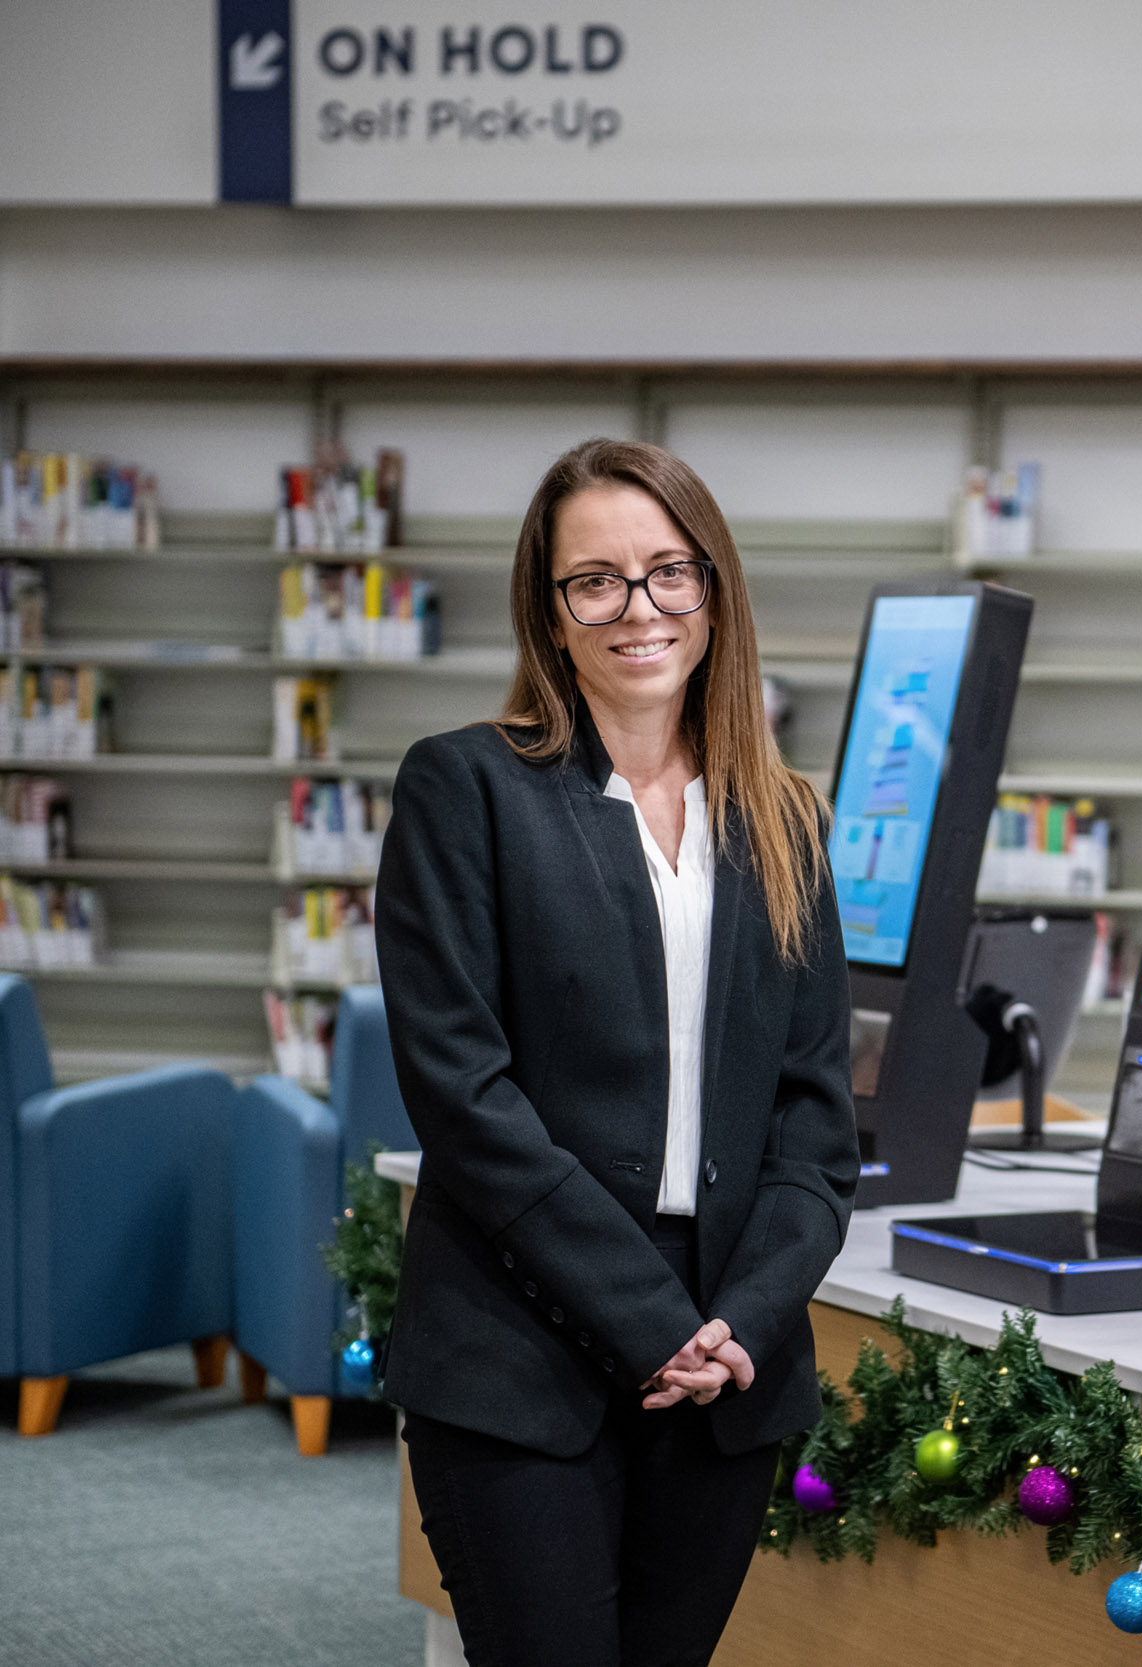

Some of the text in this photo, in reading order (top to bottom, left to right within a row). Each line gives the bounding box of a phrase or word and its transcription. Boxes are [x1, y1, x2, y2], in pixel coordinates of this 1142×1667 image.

[317, 23, 624, 77] ON HOLD
[318, 98, 622, 147] Self Pick-Up
